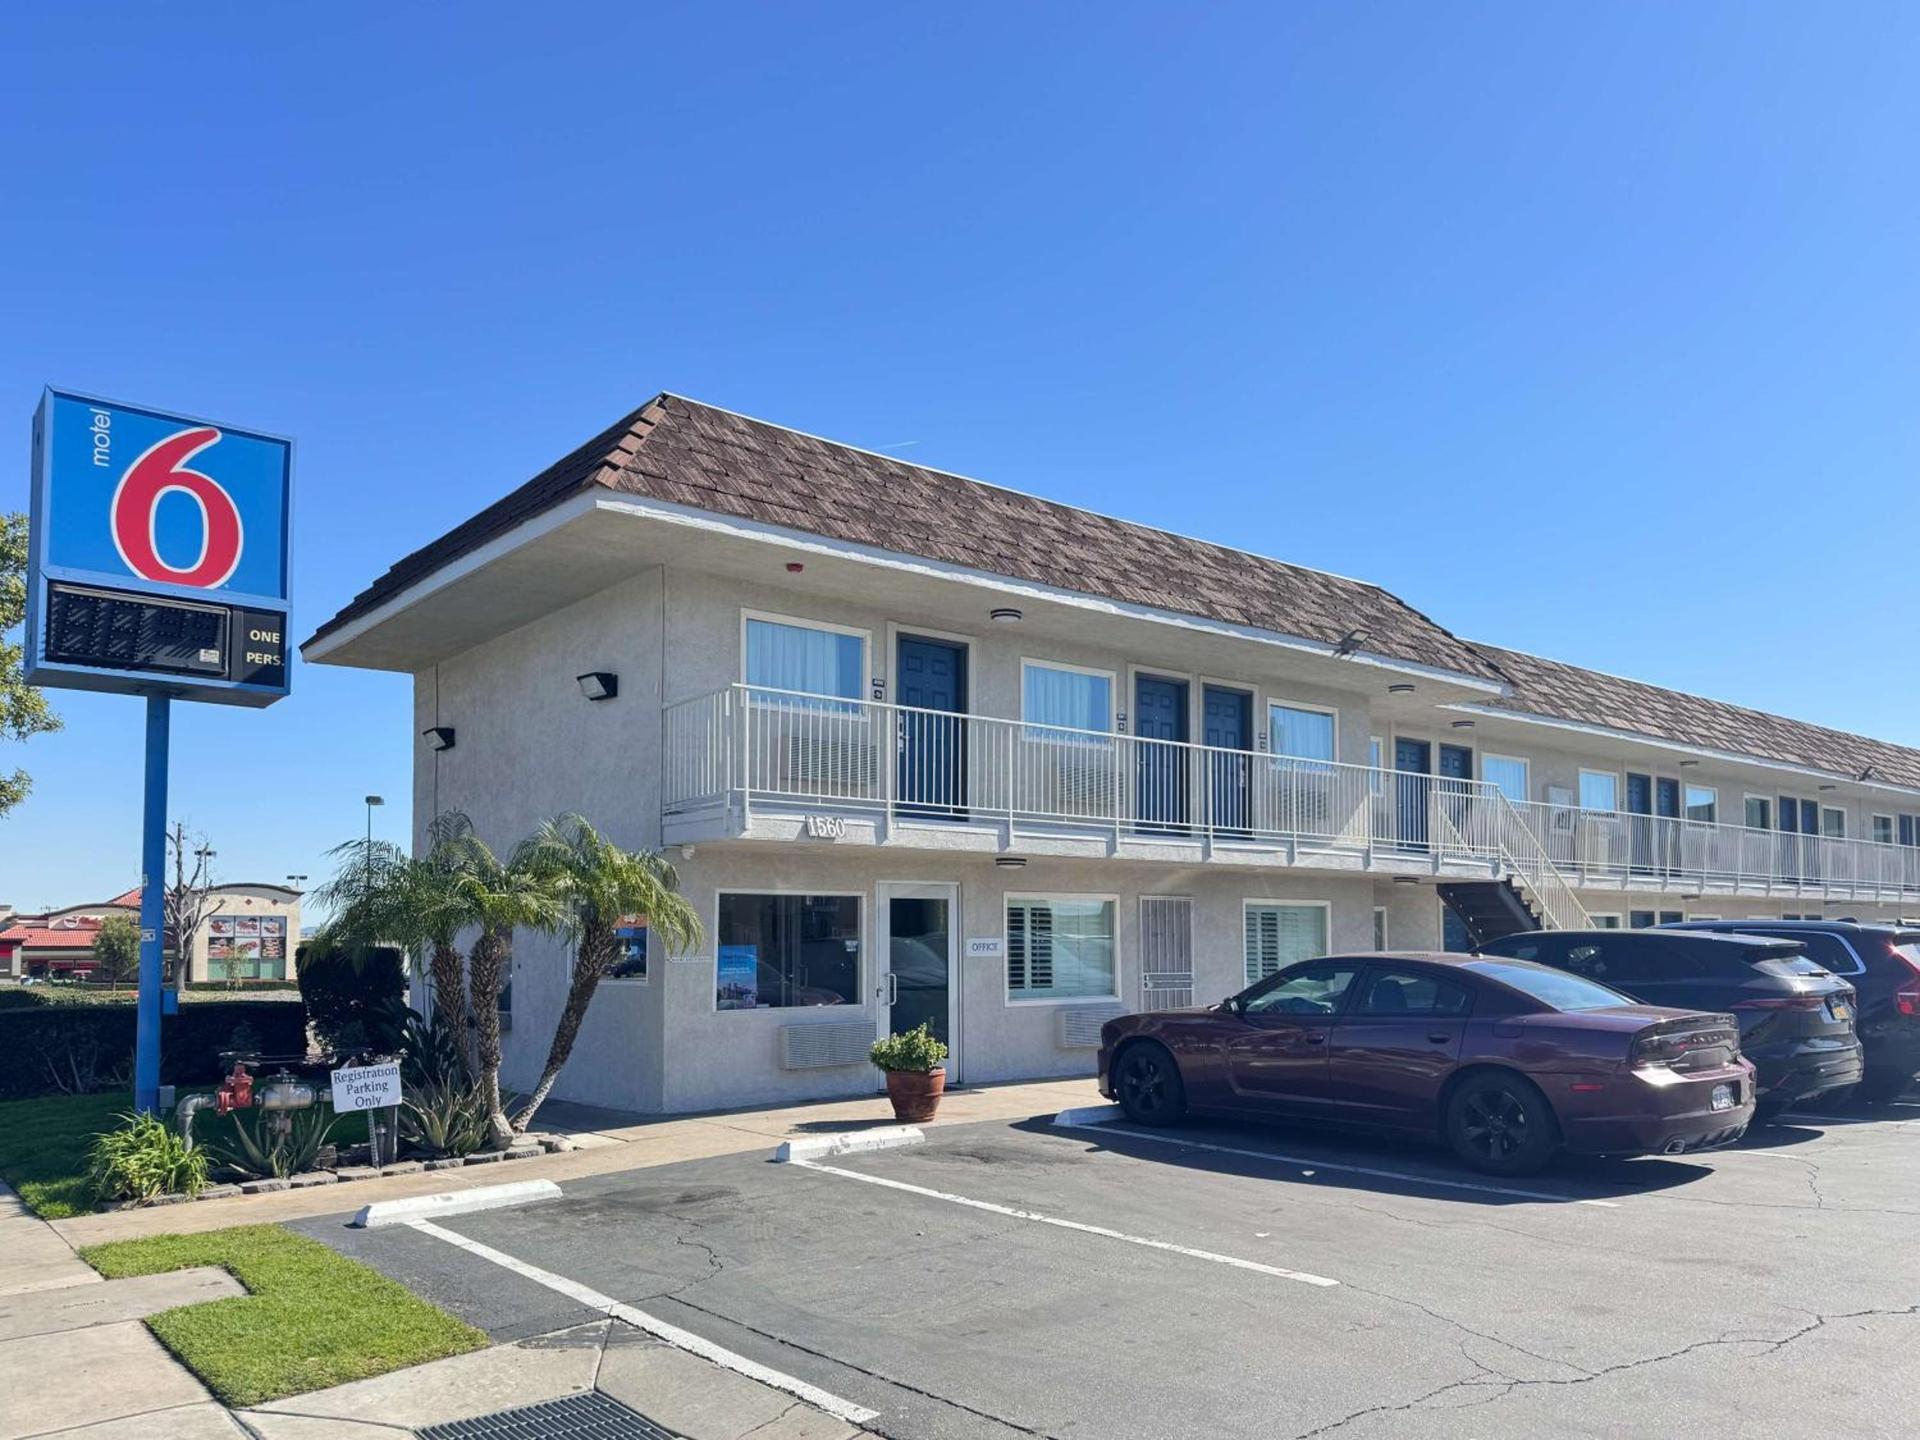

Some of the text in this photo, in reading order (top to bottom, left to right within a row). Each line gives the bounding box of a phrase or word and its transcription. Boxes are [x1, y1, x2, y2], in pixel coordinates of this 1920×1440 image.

[90, 408, 111, 467] motel
[110, 427, 244, 590] 6
[250, 629, 281, 644] ONE
[806, 816, 846, 837] 1560
[971, 942, 999, 952] OFFICE
[333, 1066, 398, 1084] Registration
[346, 1081, 389, 1095] Parking
[354, 1096, 382, 1108] Only
